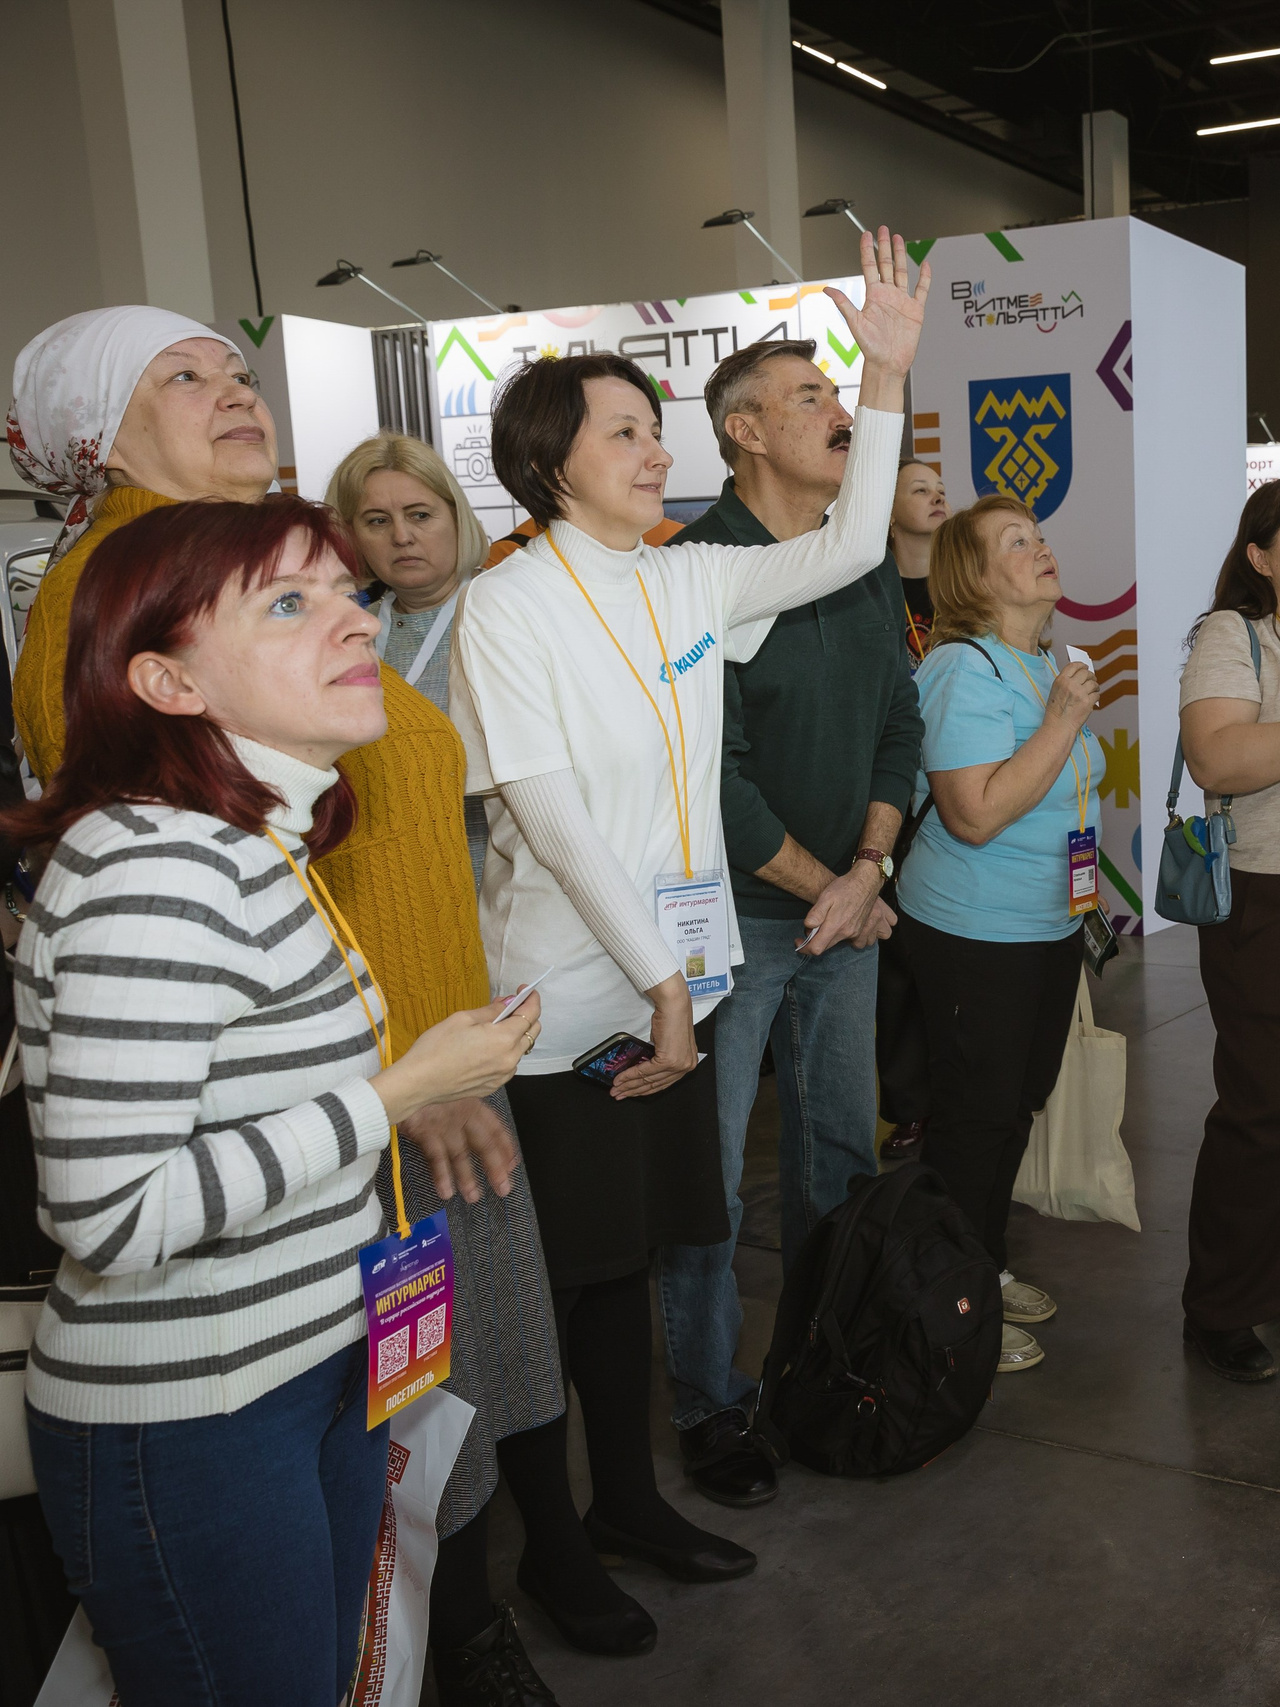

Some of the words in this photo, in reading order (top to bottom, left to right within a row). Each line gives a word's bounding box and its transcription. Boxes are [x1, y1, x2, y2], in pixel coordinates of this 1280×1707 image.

[951, 281, 972, 300] В
[964, 294, 1029, 314] РИТМЕ
[673, 631, 716, 675] КАШИН
[679, 897, 718, 908] интурмаркет
[677, 918, 709, 928] НИКИТИНА
[684, 927, 704, 935] ОЛЬГА
[689, 980, 720, 992] ЕТИТЕЛЬ
[376, 1264, 446, 1316] ИНТУРМАРКЕТ
[386, 1370, 435, 1412] ПОСЕТИТЕЛЬ
